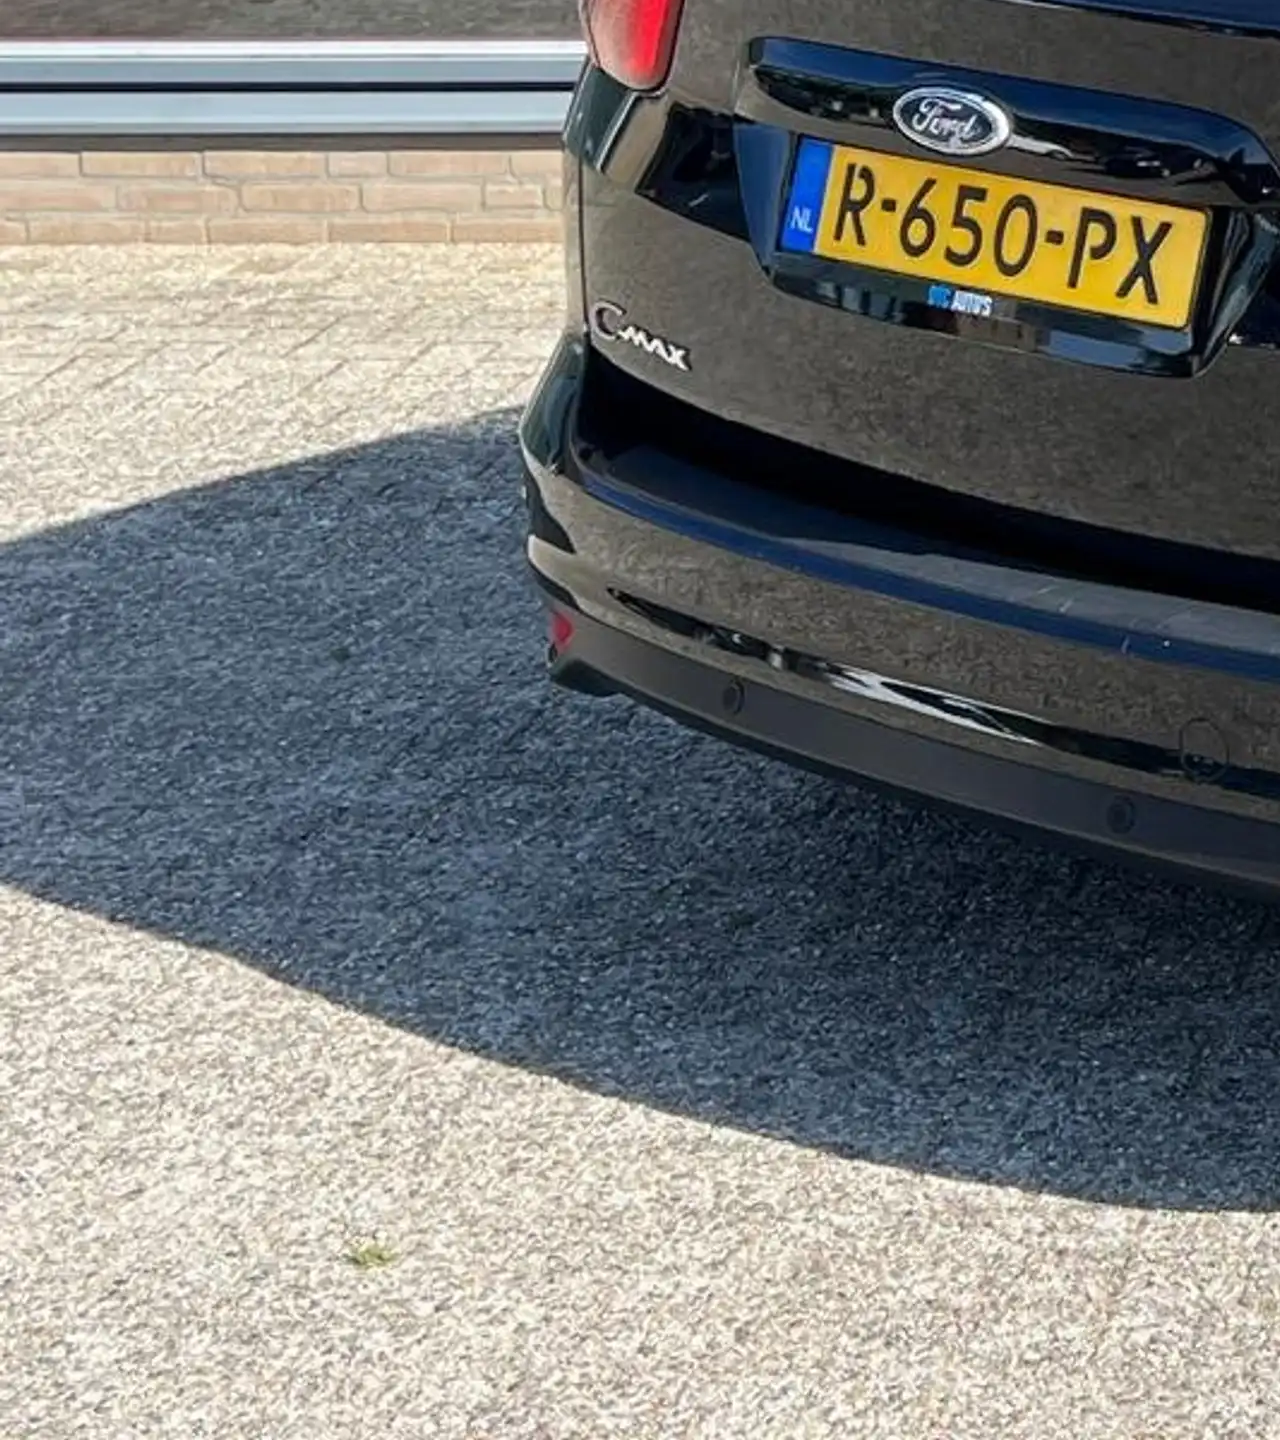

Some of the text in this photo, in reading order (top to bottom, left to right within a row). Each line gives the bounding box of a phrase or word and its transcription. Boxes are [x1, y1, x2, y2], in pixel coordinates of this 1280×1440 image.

[911, 98, 984, 142] Ford
[790, 206, 813, 233] NL
[833, 161, 1172, 305] R-650-PX
